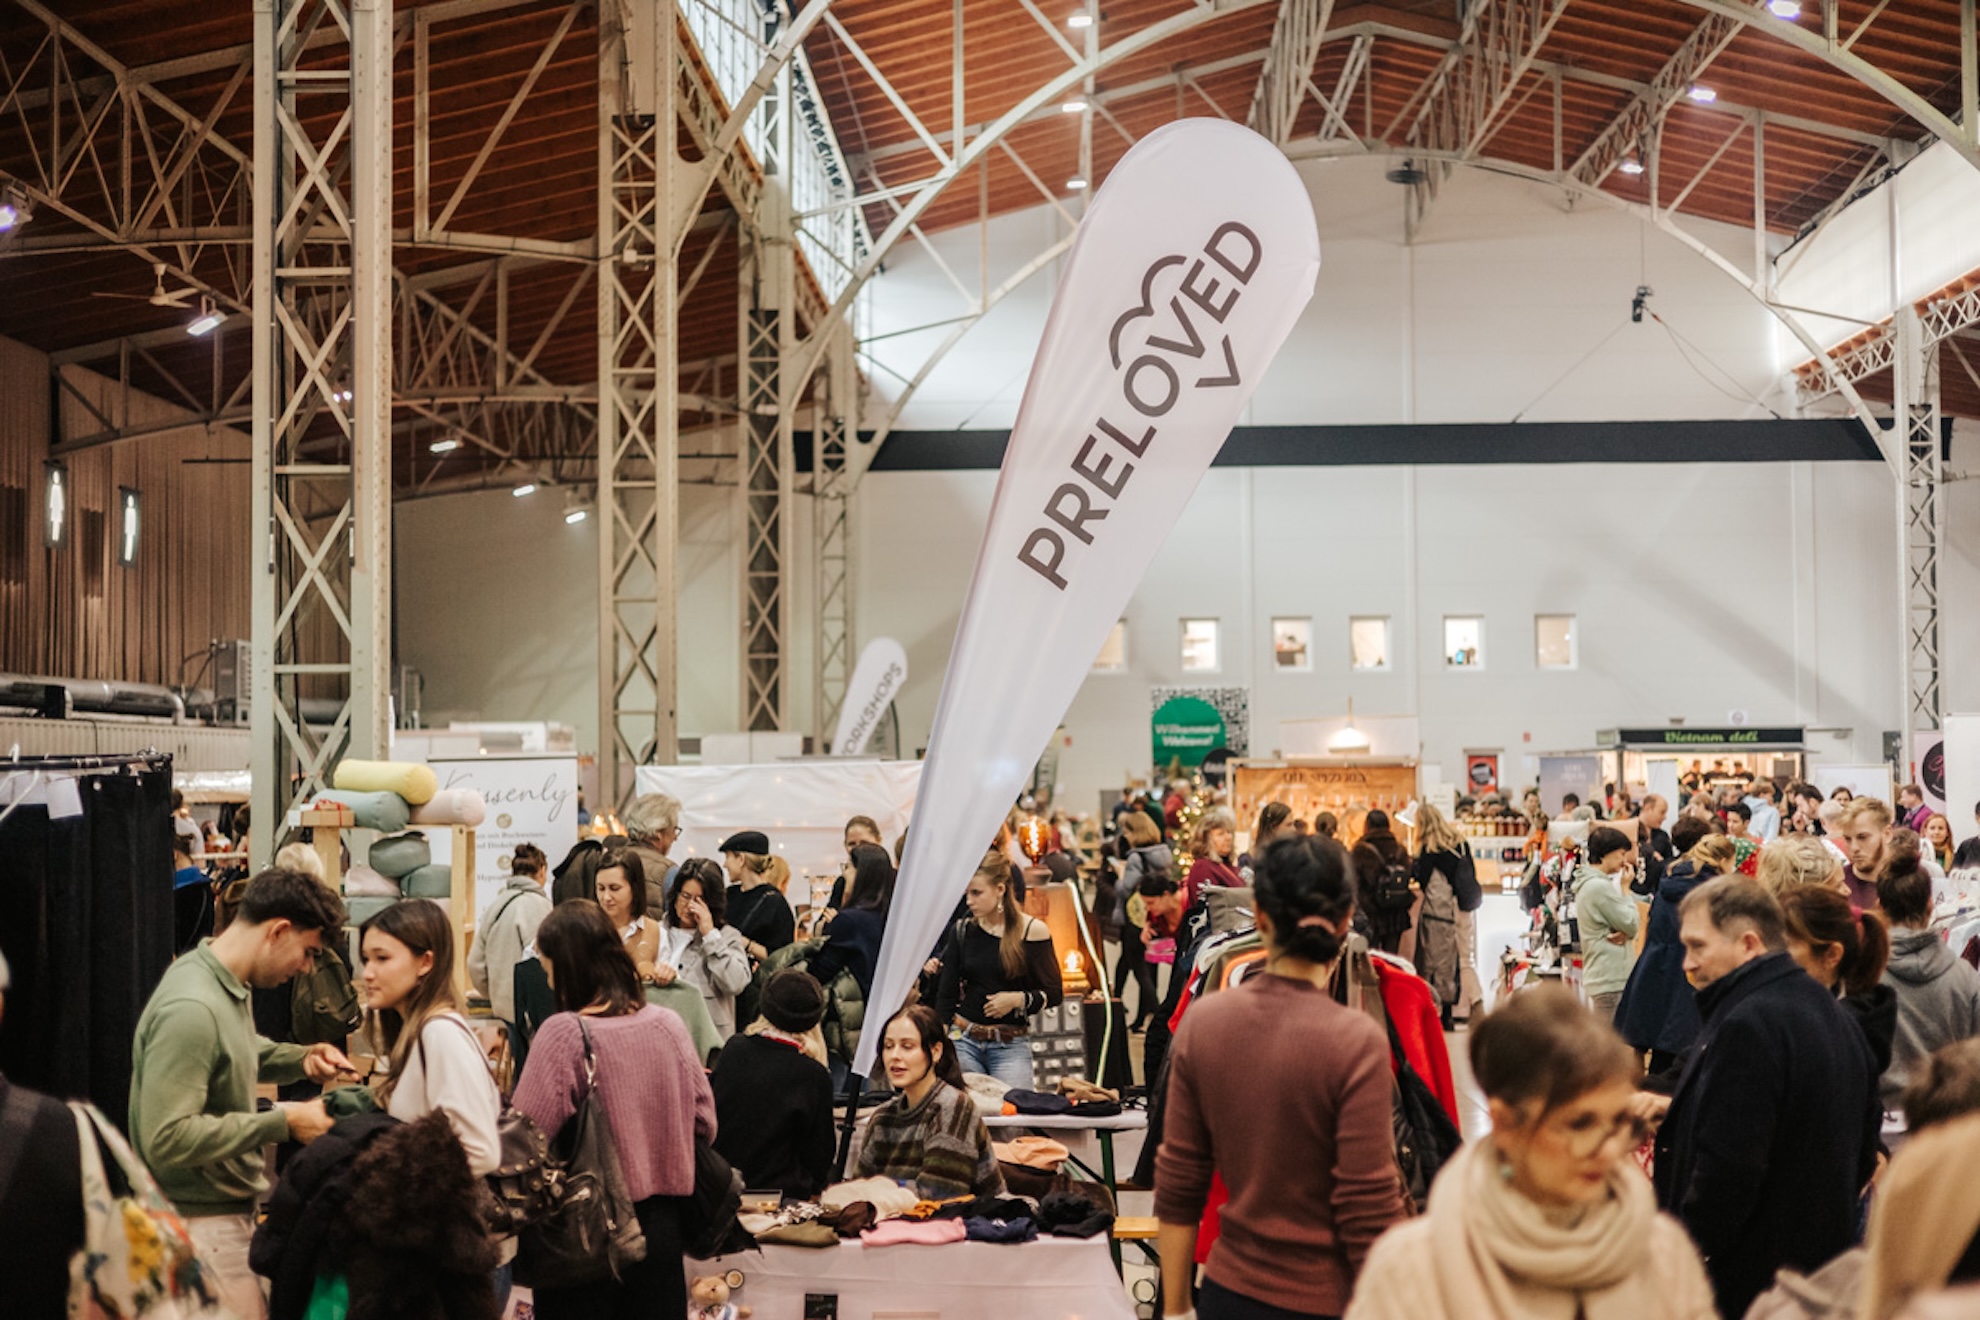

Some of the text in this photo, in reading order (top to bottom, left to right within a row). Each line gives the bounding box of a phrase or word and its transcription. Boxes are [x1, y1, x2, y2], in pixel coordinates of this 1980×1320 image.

[1017, 221, 1263, 592] PRELOVED
[842, 661, 903, 755] ORKSHOPS
[1664, 730, 1759, 743] Vietnam deli
[443, 768, 574, 822] Kssenly
